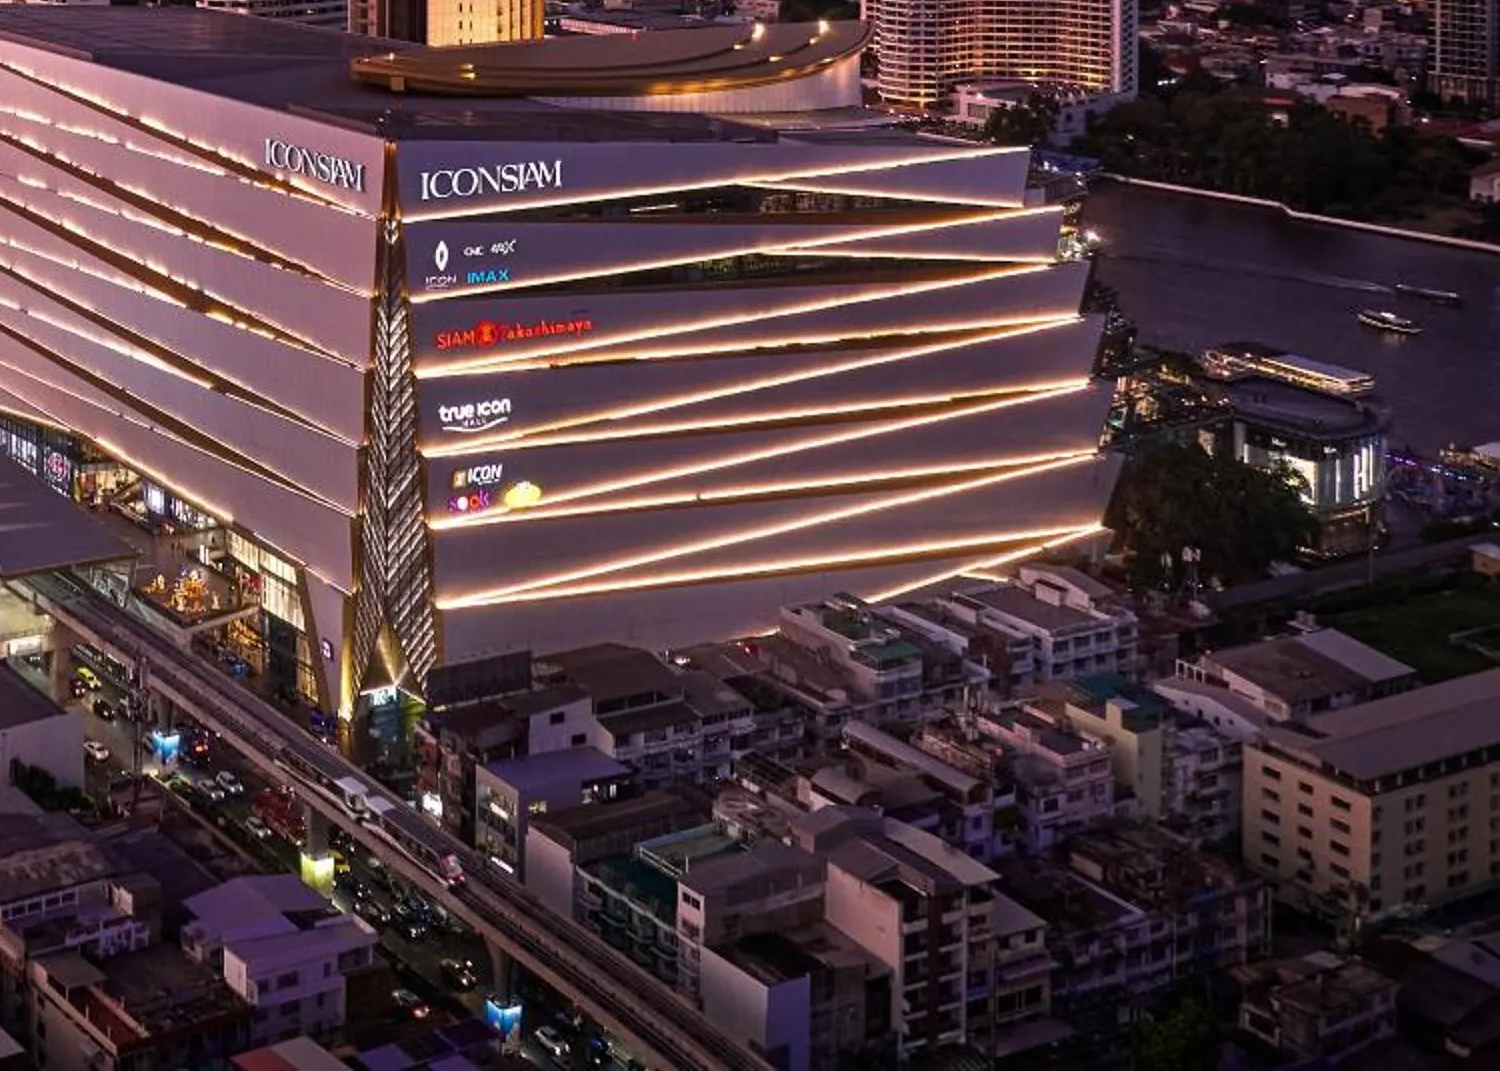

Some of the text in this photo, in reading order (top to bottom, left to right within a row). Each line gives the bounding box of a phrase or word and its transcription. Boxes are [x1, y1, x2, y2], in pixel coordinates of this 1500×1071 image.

[264, 137, 364, 193] ICONSIAM
[420, 160, 562, 200] ICONSIAM
[466, 269, 509, 284] IMAX
[436, 331, 475, 351] SIAM
[438, 404, 475, 422] true
[467, 464, 503, 484] ICON
